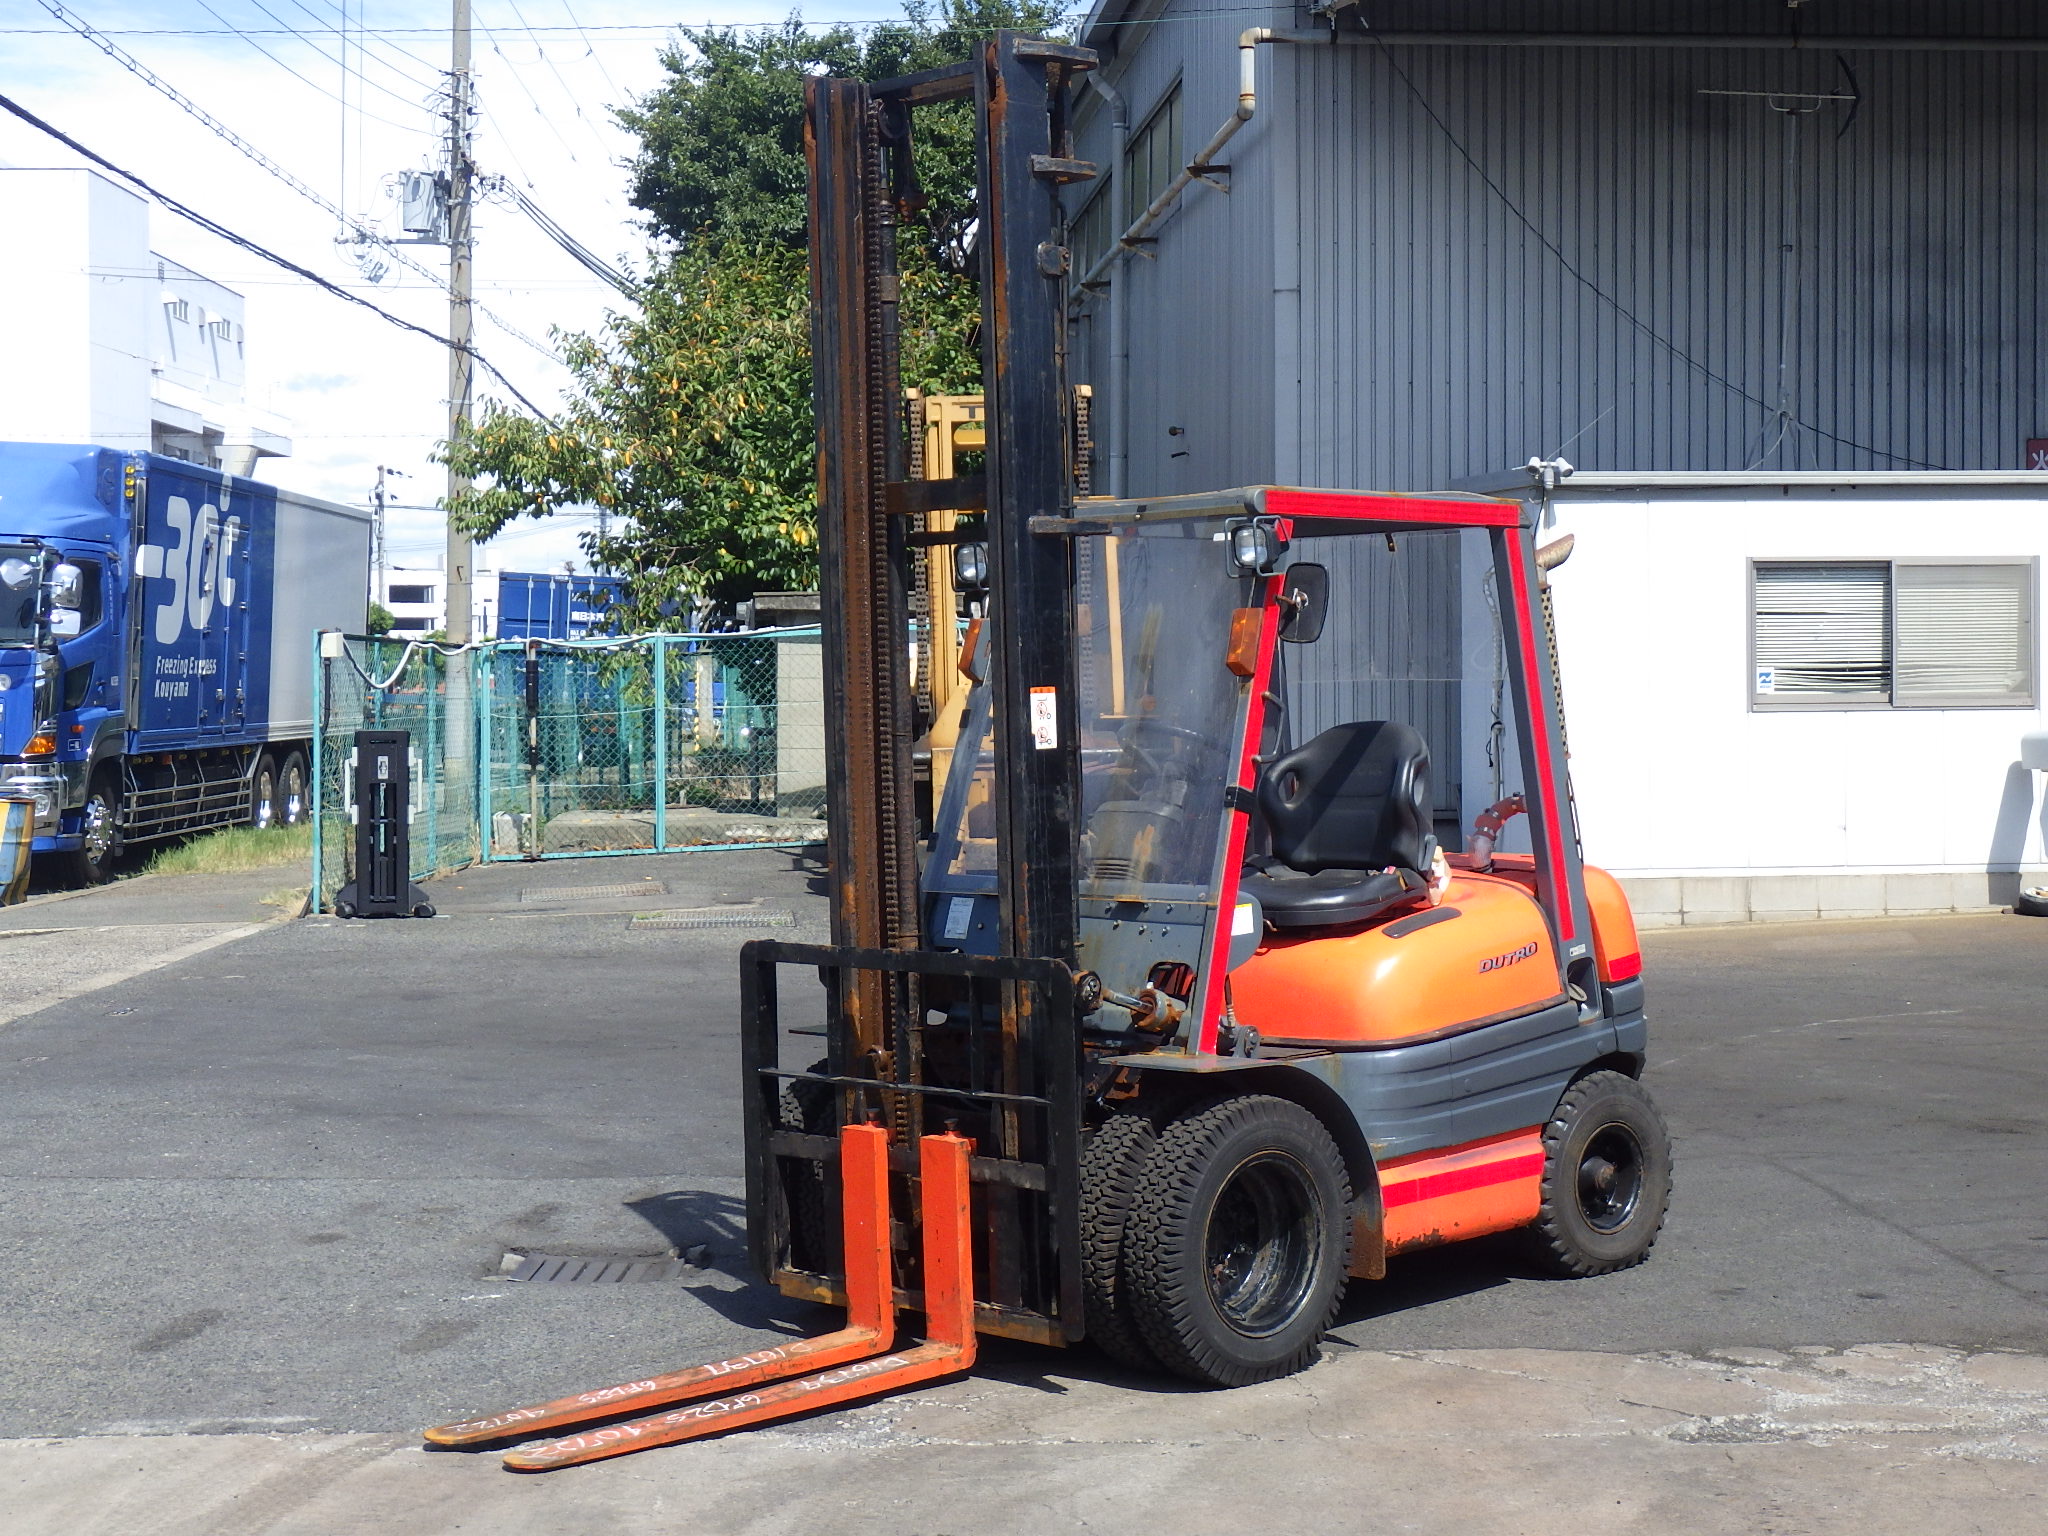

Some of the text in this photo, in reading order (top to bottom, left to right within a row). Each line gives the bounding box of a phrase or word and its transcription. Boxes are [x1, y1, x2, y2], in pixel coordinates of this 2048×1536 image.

[155, 654, 217, 679] Freezing Express
[154, 679, 189, 701] Kouyama
[1478, 941, 1538, 974] DUTRO
